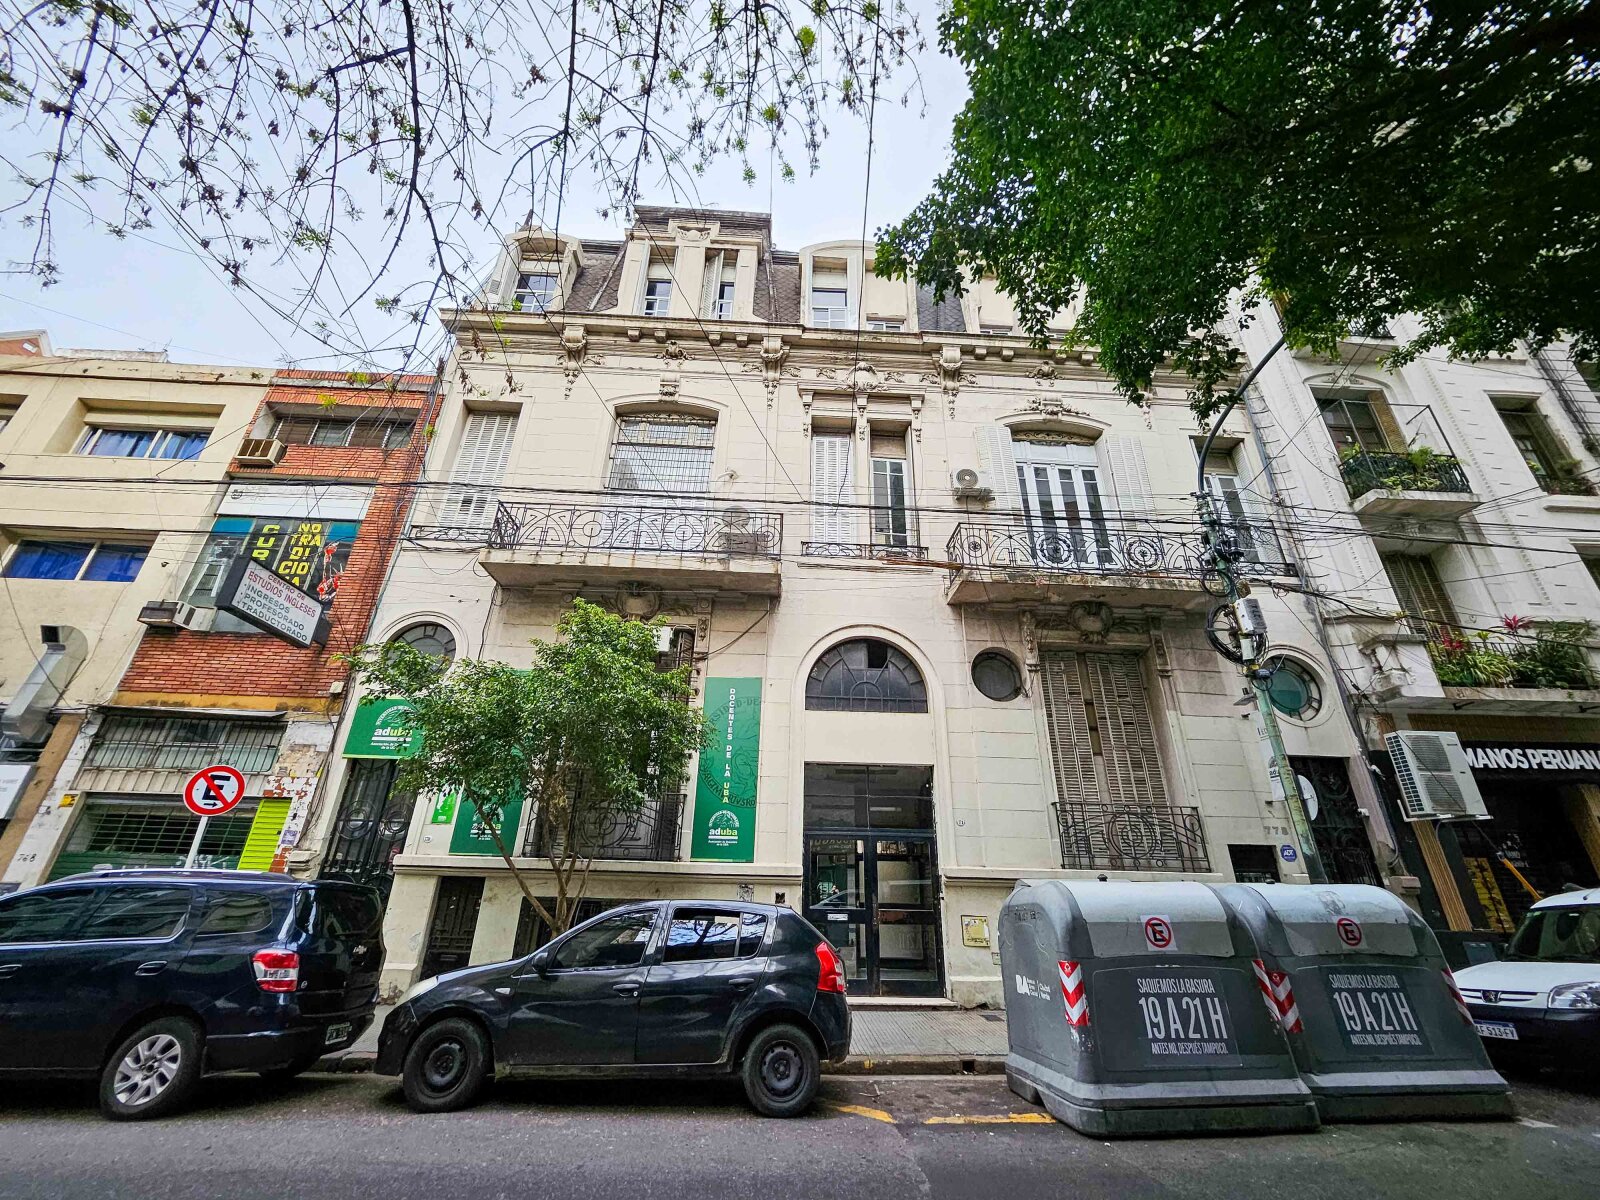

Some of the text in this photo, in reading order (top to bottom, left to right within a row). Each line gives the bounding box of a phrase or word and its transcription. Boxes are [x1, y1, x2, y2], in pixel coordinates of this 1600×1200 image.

[298, 522, 322, 533] NO
[290, 534, 321, 546] TRA
[278, 560, 309, 574] CIO
[247, 570, 317, 618] ESTUDIOS INGLESES
[247, 584, 291, 614] INGRESOS
[267, 574, 306, 601] CENTRO DE
[241, 601, 308, 642] TRADUCTORADO
[243, 592, 305, 631] PROFESORADO
[722, 688, 736, 803] DOCENTES DE LA UBA
[1524, 748, 1600, 769] PERUAN
[202, 774, 231, 801] E
[709, 828, 738, 836] aduba
[1151, 922, 1166, 942] E
[1137, 978, 1216, 993] SAQUEMOS LA BASURA
[1328, 974, 1400, 988] SAQUEMOS LA BASURA
[1138, 996, 1228, 1039] 19 A 21 H
[1333, 991, 1418, 1031] 19 A 21 H
[1151, 1042, 1170, 1054] ANTES
